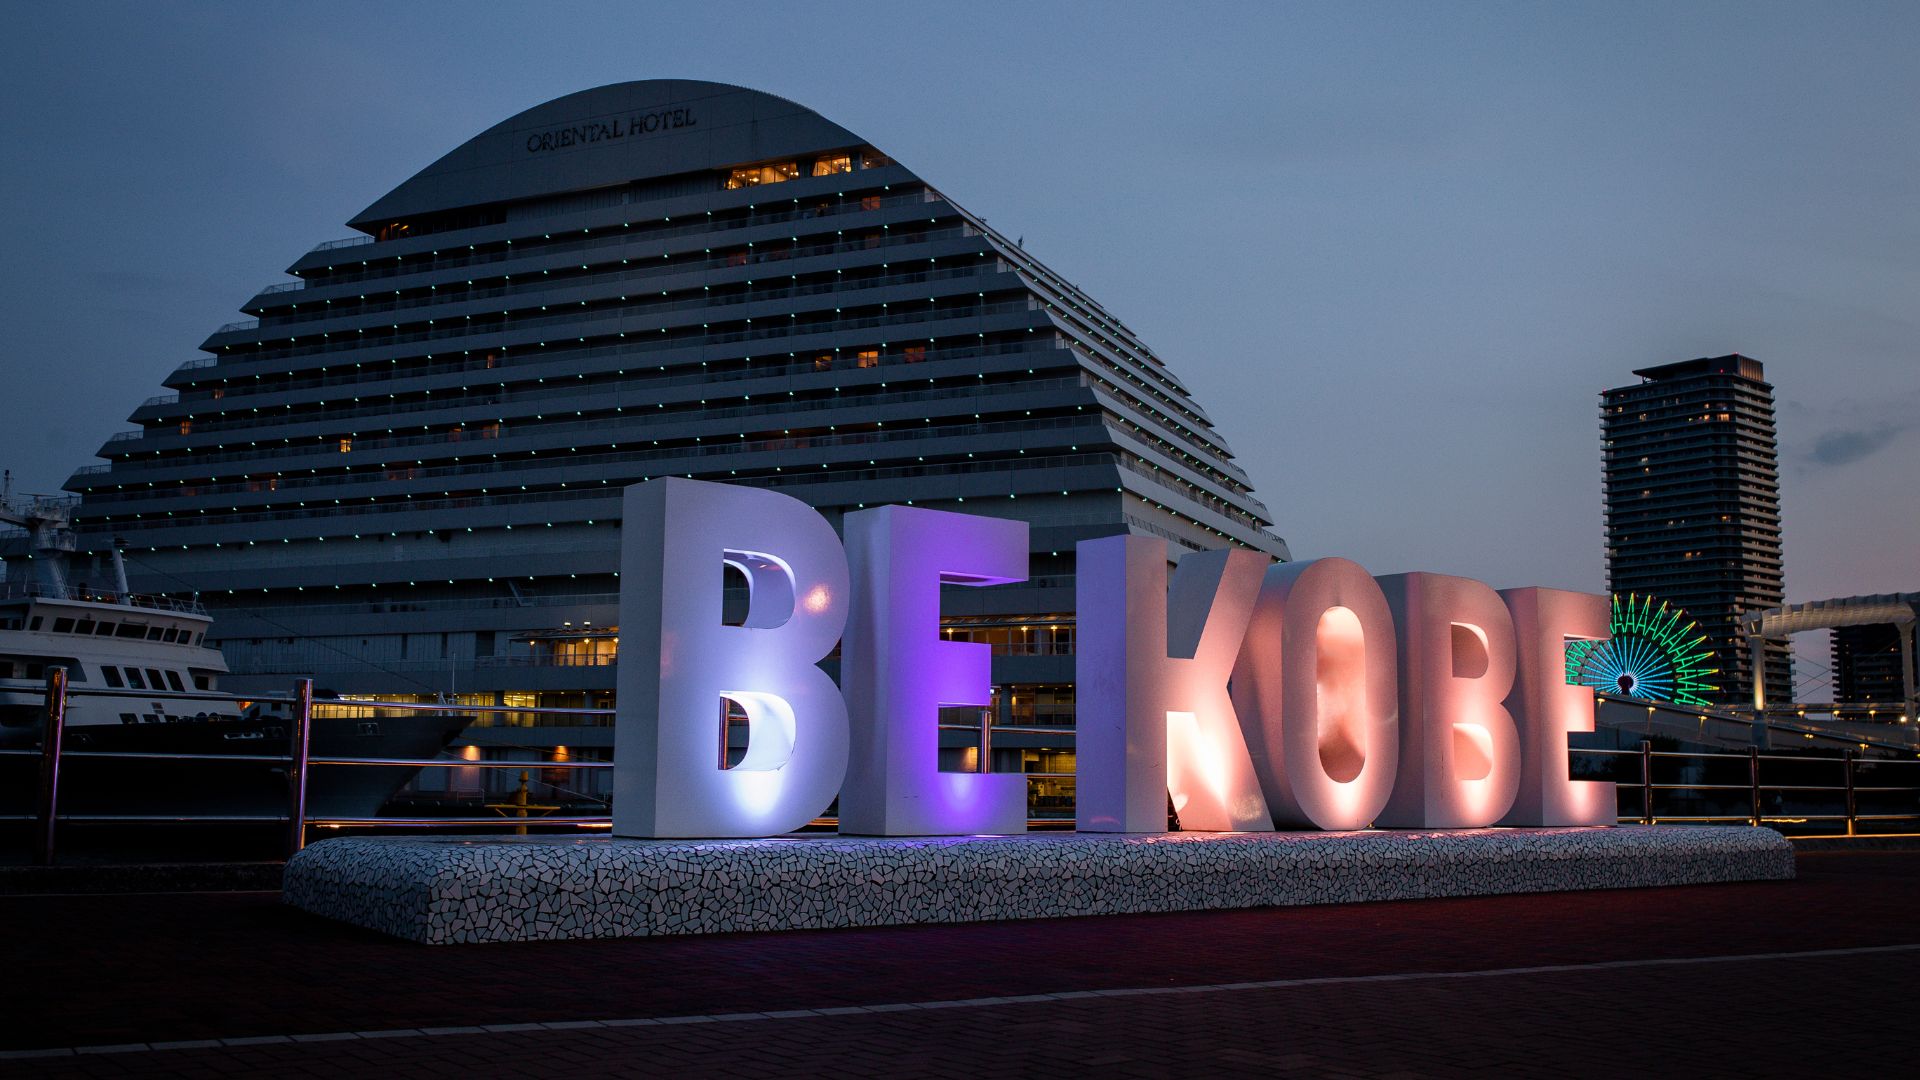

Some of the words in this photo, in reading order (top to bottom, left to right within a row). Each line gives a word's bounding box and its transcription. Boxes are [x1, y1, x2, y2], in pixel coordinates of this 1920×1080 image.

[527, 119, 624, 153] ORIENTAL
[629, 108, 697, 136] HOTEL
[612, 476, 1030, 839] BE
[1076, 534, 1618, 833] KOBE
